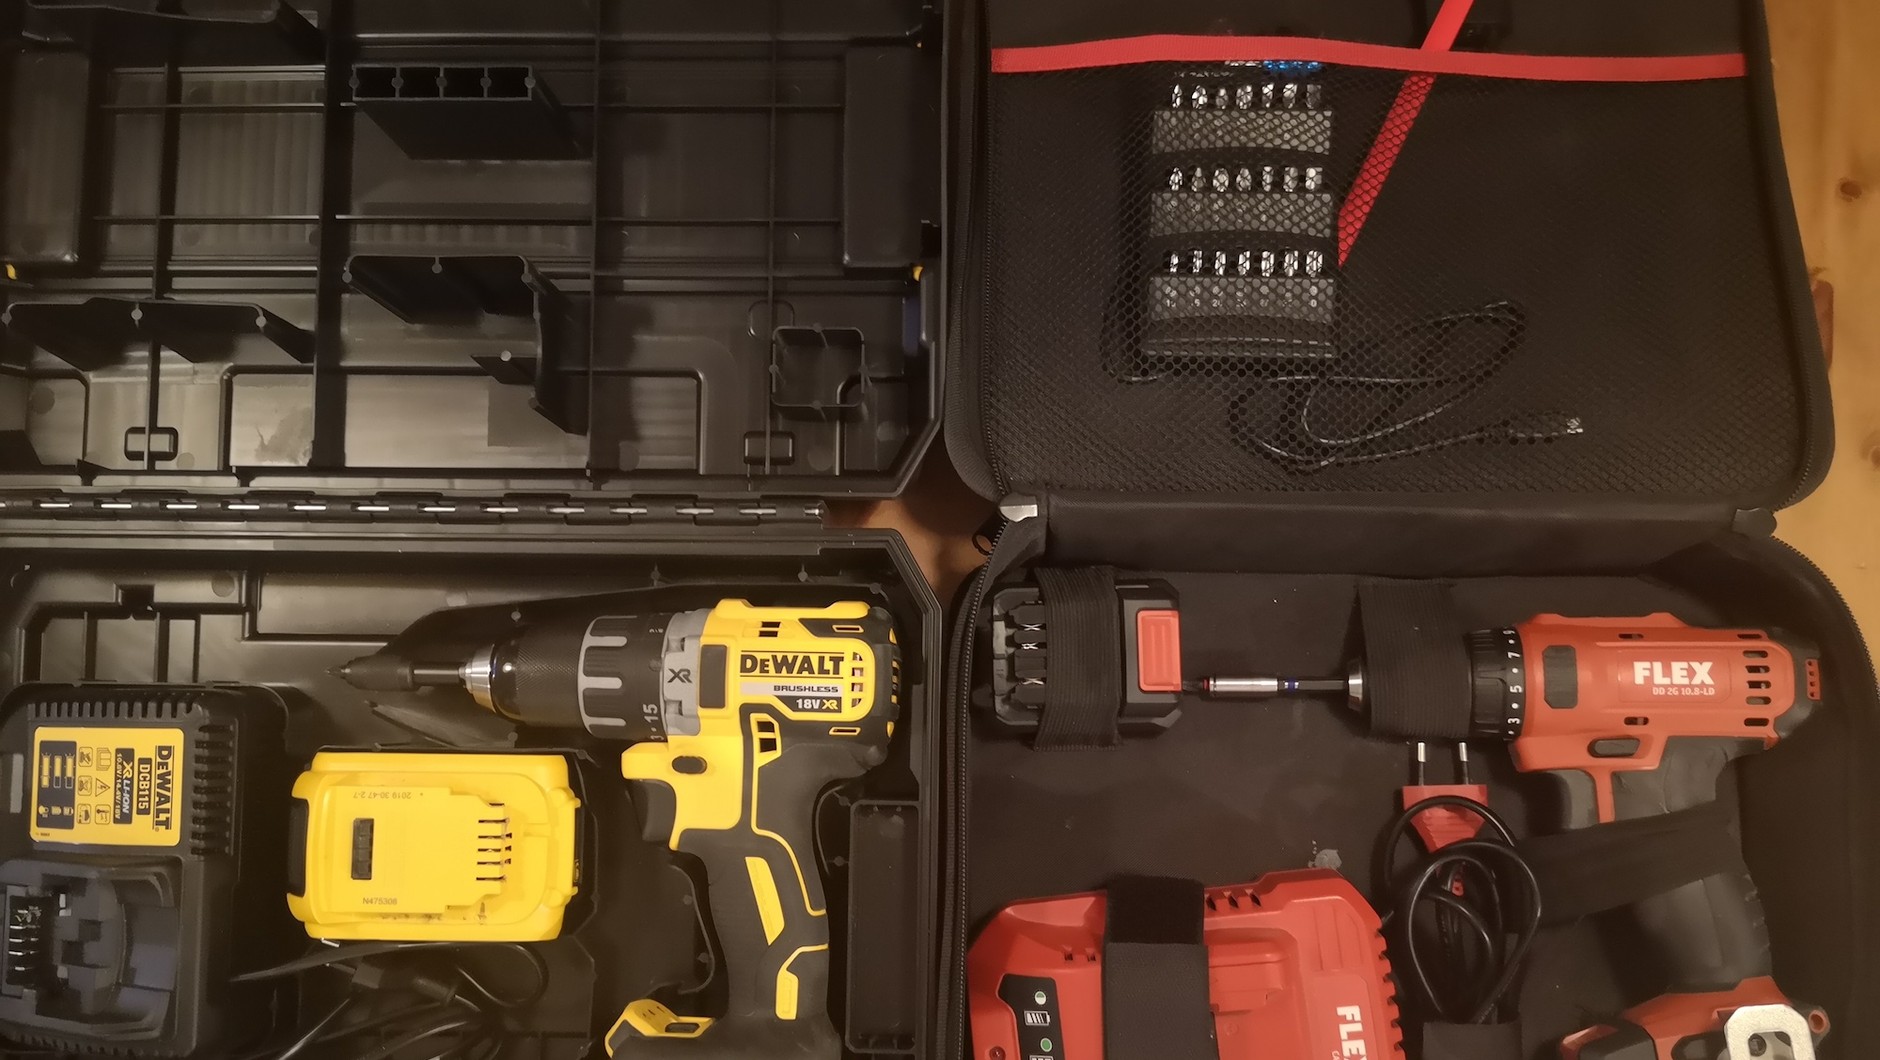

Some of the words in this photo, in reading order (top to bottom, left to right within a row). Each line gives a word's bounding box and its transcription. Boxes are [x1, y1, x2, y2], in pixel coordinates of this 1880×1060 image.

[667, 668, 692, 683] XR
[1633, 661, 1715, 685] FLEX
[773, 685, 839, 693] BRUSHLESS
[1509, 685, 1522, 693] 5
[1652, 687, 1666, 695] DD
[1667, 687, 1679, 695] 2G
[1681, 687, 1715, 696] 10.8-LD
[643, 703, 659, 723] 15
[796, 699, 820, 709] 18V
[822, 699, 838, 710] XR
[123, 761, 133, 779] XR
[138, 764, 150, 810] DCB115
[122, 779, 130, 814] LI-ION
[1336, 1005, 1368, 1060] FLE
